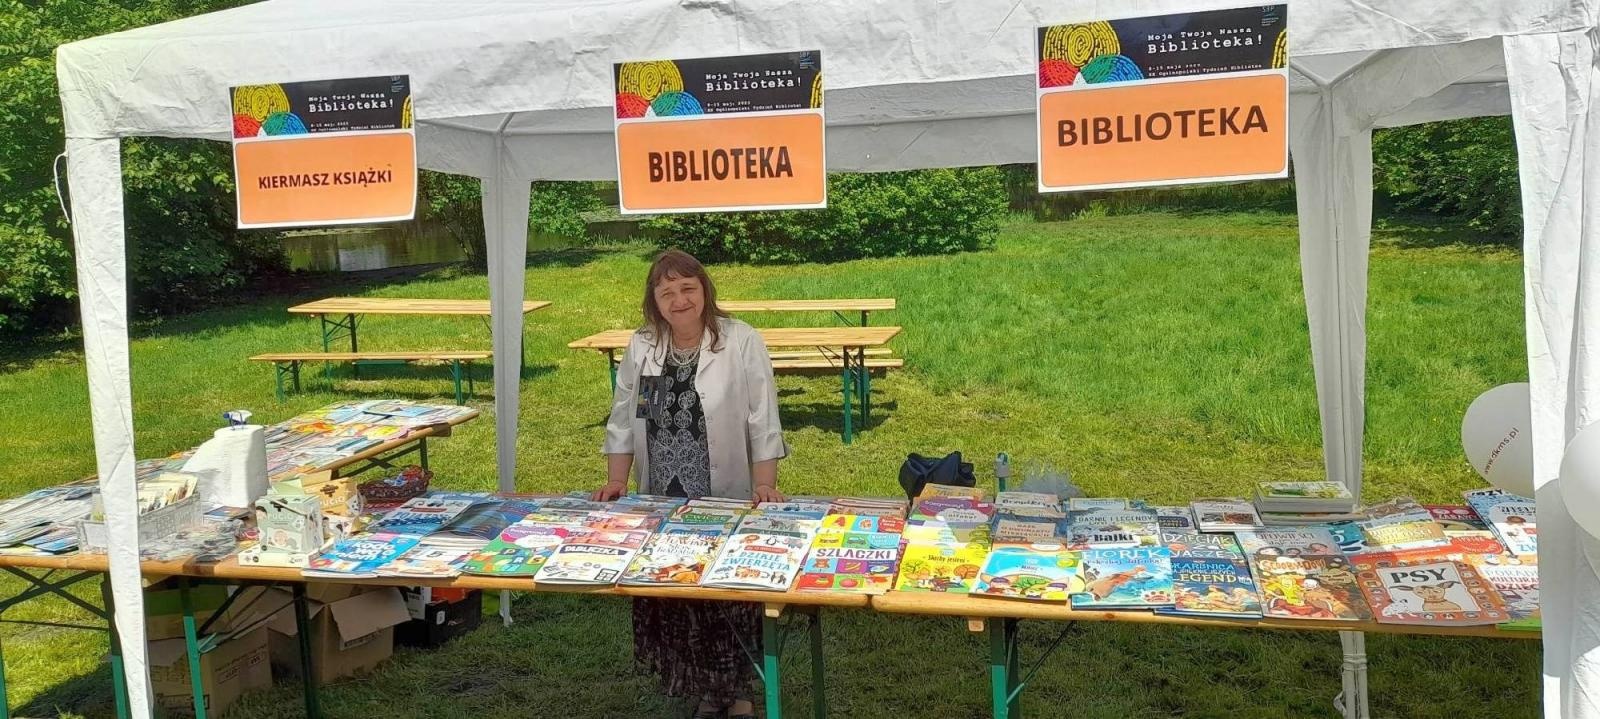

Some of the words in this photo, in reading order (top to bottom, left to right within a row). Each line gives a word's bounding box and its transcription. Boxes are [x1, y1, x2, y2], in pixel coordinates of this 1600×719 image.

[1148, 34, 1262, 54] Biblioteka!
[706, 77, 801, 92] Biblioteka!
[309, 99, 394, 113] Biblioteka!
[1058, 105, 1268, 147] BIBLIOTEKA
[649, 146, 793, 182] BIBLIOTEKA
[258, 173, 330, 189] KIERMASZ
[334, 168, 392, 188] KSIĄŻKI
[1484, 427, 1520, 475] www.dkms.pl
[1094, 534, 1134, 542] Bajki
[1162, 532, 1234, 544] DZIECIAKI
[565, 546, 619, 555] TABLICZKA
[739, 552, 782, 562] DZIKIE
[816, 548, 891, 560] SZLACZKI
[1083, 550, 1165, 559] FLOREK
[722, 558, 790, 570] ZWIERZĘTA
[1390, 568, 1447, 584] PSY
